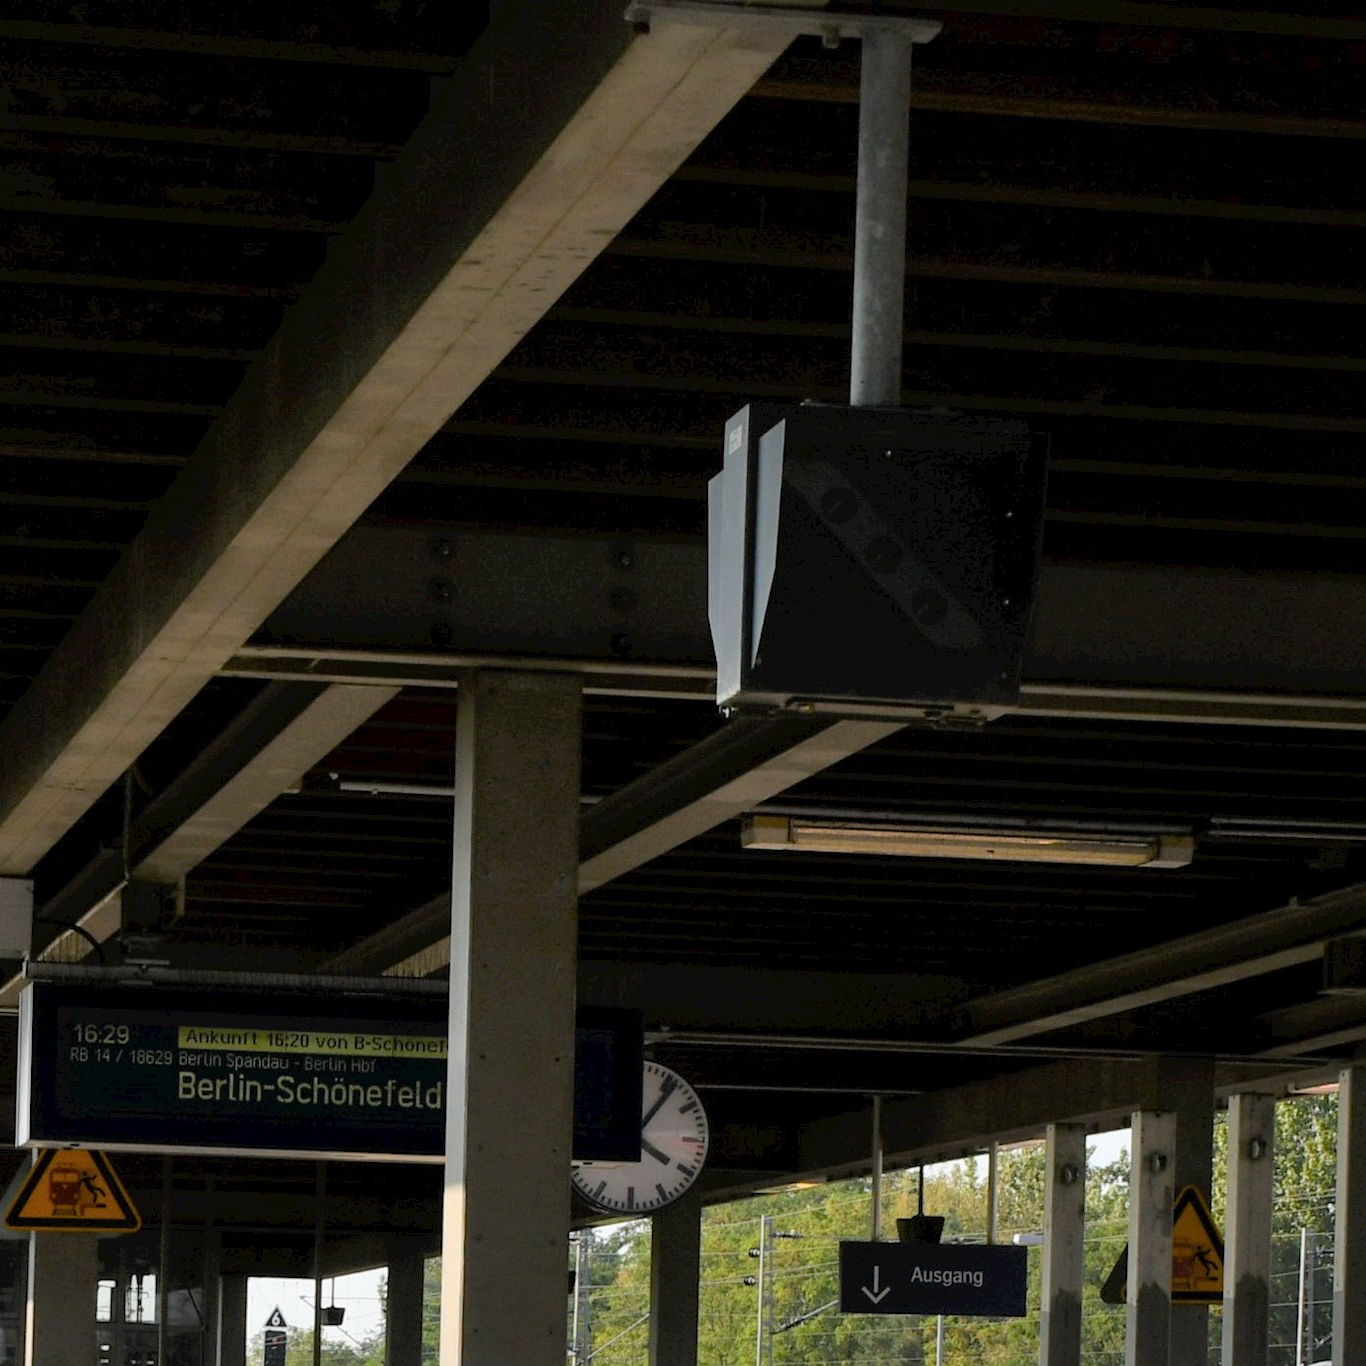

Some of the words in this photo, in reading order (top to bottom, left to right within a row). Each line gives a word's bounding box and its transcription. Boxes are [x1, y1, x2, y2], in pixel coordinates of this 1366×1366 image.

[73, 1023, 130, 1045] 16:29
[186, 1028, 258, 1046] Ankunft
[268, 1032, 309, 1048] 16:20
[316, 1037, 348, 1050] von
[70, 1046, 88, 1062] RB
[95, 1048, 110, 1063] 14
[116, 1049, 124, 1063] /
[131, 1050, 173, 1066] 18629
[178, 1050, 221, 1067] Berlin
[226, 1053, 289, 1071] Spandau
[304, 1056, 347, 1072] Berlin
[351, 1057, 378, 1073] Hbf
[178, 1070, 443, 1109] Berlin-Schönefeld
[910, 1265, 984, 1288] Ausgang
[271, 1311, 281, 1326] 6
